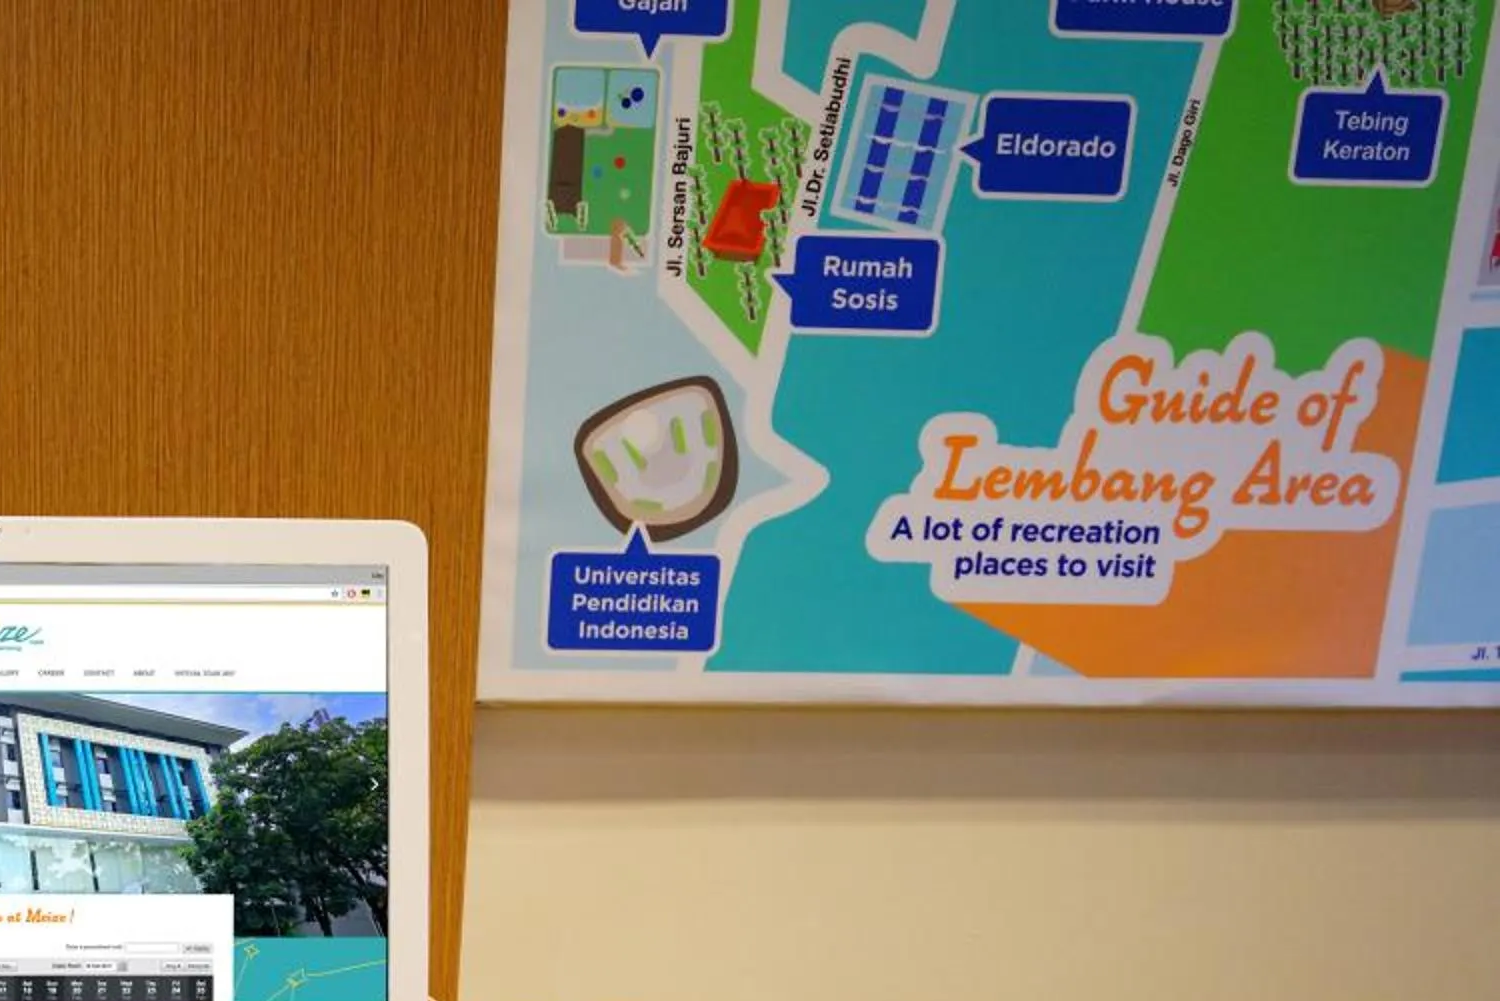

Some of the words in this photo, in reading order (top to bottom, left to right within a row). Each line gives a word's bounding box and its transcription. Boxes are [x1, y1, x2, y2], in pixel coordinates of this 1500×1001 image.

[813, 57, 852, 161] Setiabudhi
[1171, 129, 1193, 167] Dago
[1183, 99, 1201, 126] Giri
[1334, 110, 1410, 136] Tebing
[671, 117, 693, 175] Bajuri
[995, 133, 1117, 158] Eldorado
[1322, 140, 1411, 163] Keraton
[667, 180, 688, 249] Sersan
[823, 255, 914, 279] Rumah
[831, 287, 899, 311] Sosis
[1099, 354, 1280, 427] Guide
[1296, 360, 1365, 452] of
[933, 428, 1216, 538] Lembang
[1231, 439, 1375, 506] Area
[891, 518, 913, 541] A
[923, 516, 962, 541] lot
[972, 516, 1003, 542] of
[1010, 519, 1161, 545] recreation
[574, 565, 701, 587] Universitas
[953, 551, 1048, 580] places
[1057, 554, 1087, 577] to
[1096, 552, 1156, 579] visit
[571, 593, 700, 614] Pendidikan
[578, 621, 689, 641] Indonesia
[6, 910, 22, 923] at
[25, 907, 67, 924] Meize
